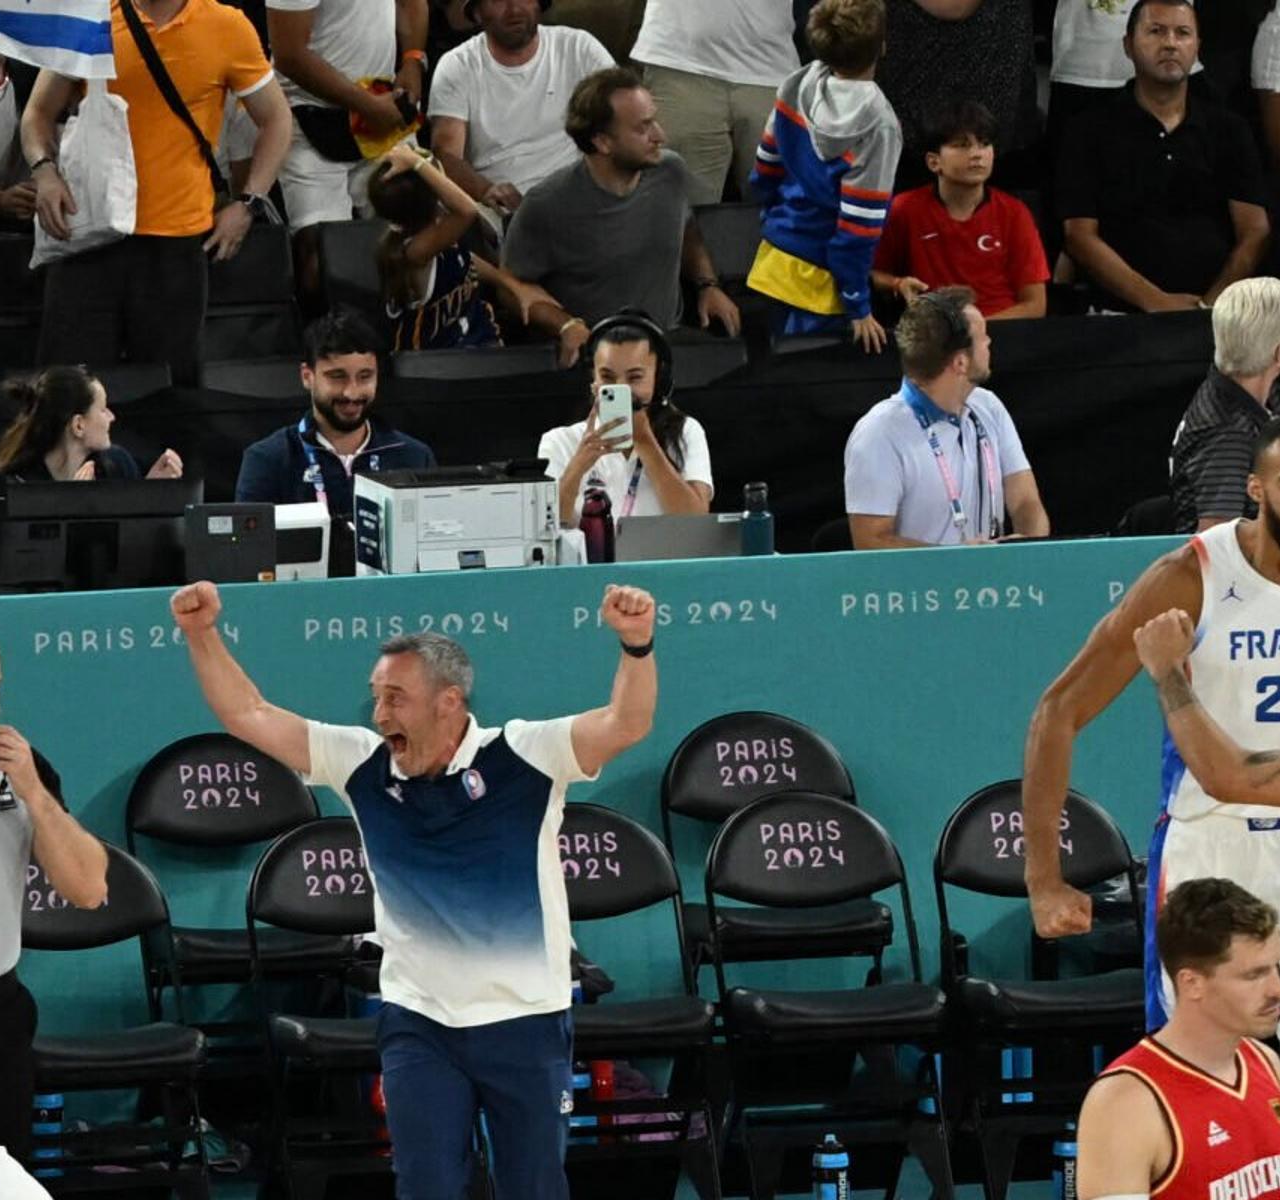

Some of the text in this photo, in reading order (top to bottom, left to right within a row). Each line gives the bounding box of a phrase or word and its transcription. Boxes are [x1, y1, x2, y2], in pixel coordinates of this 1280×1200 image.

[955, 584, 1044, 611] 2024
[686, 600, 777, 626] 2024
[720, 764, 796, 787] 2024
[183, 787, 260, 809] 2024
[764, 846, 845, 870] 2024
[305, 873, 366, 896] 202
